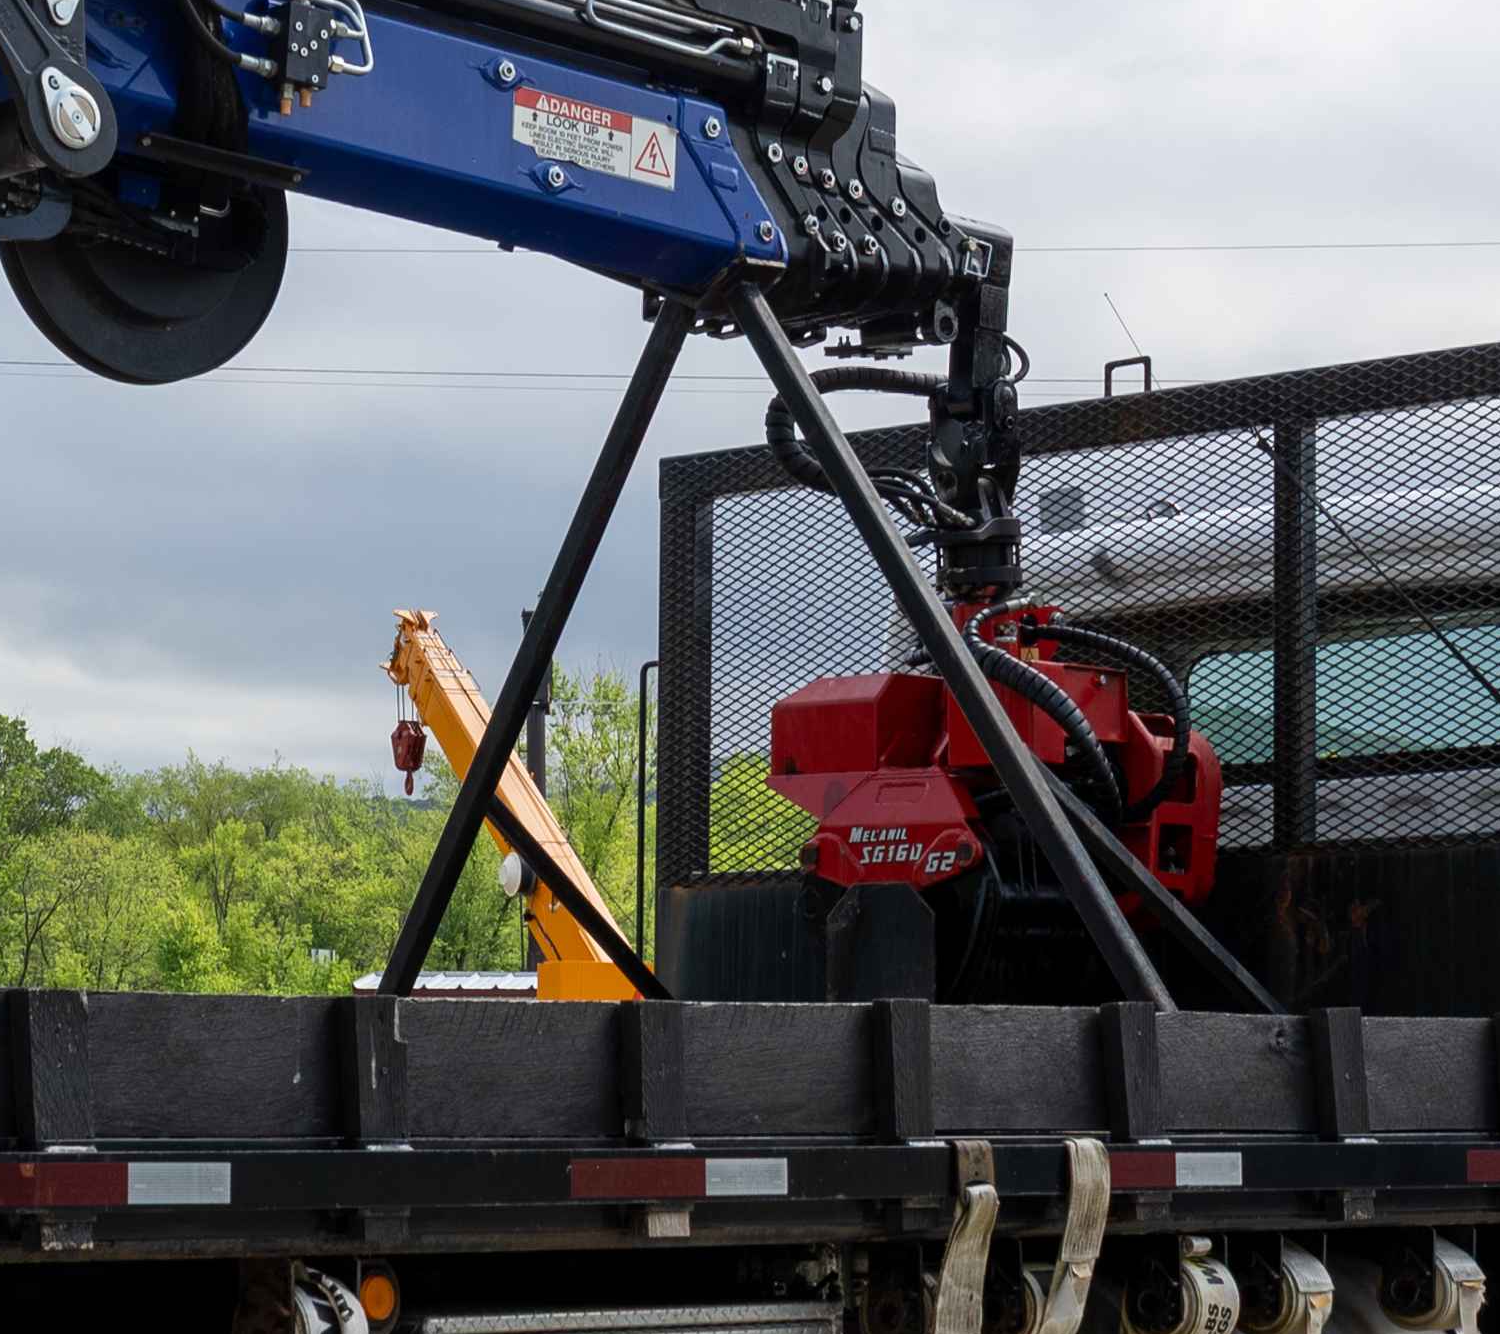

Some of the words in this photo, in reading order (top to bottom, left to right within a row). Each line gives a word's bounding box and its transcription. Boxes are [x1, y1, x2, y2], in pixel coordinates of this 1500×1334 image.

[547, 114, 579, 132] LOOK
[584, 124, 600, 136] UP
[550, 98, 612, 127] DANGER
[521, 121, 537, 129] KEEP
[538, 125, 557, 135] BOOM
[567, 132, 581, 141] FEET
[583, 136, 600, 145] FROM
[602, 141, 623, 152] POWER
[578, 142, 598, 153] SHOCK
